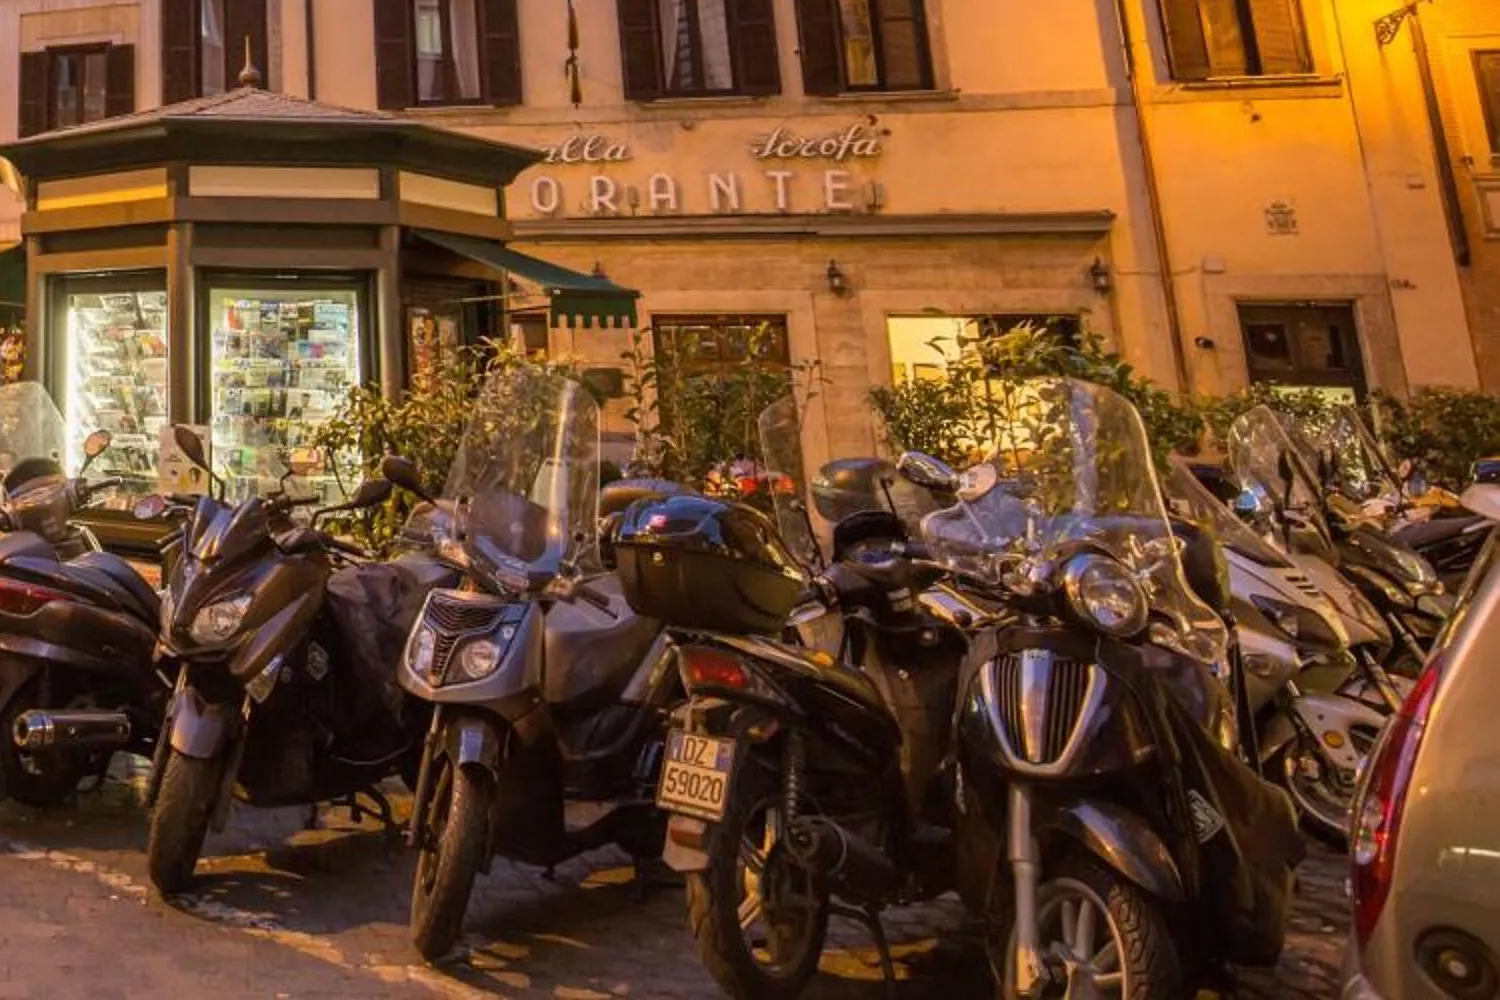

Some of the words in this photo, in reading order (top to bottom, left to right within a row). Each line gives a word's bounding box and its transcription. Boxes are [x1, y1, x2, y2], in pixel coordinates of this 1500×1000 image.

[753, 123, 881, 161] Scrofa
[531, 169, 854, 213] ORANTE
[683, 737, 709, 765] DZ
[664, 766, 724, 805] 59020
